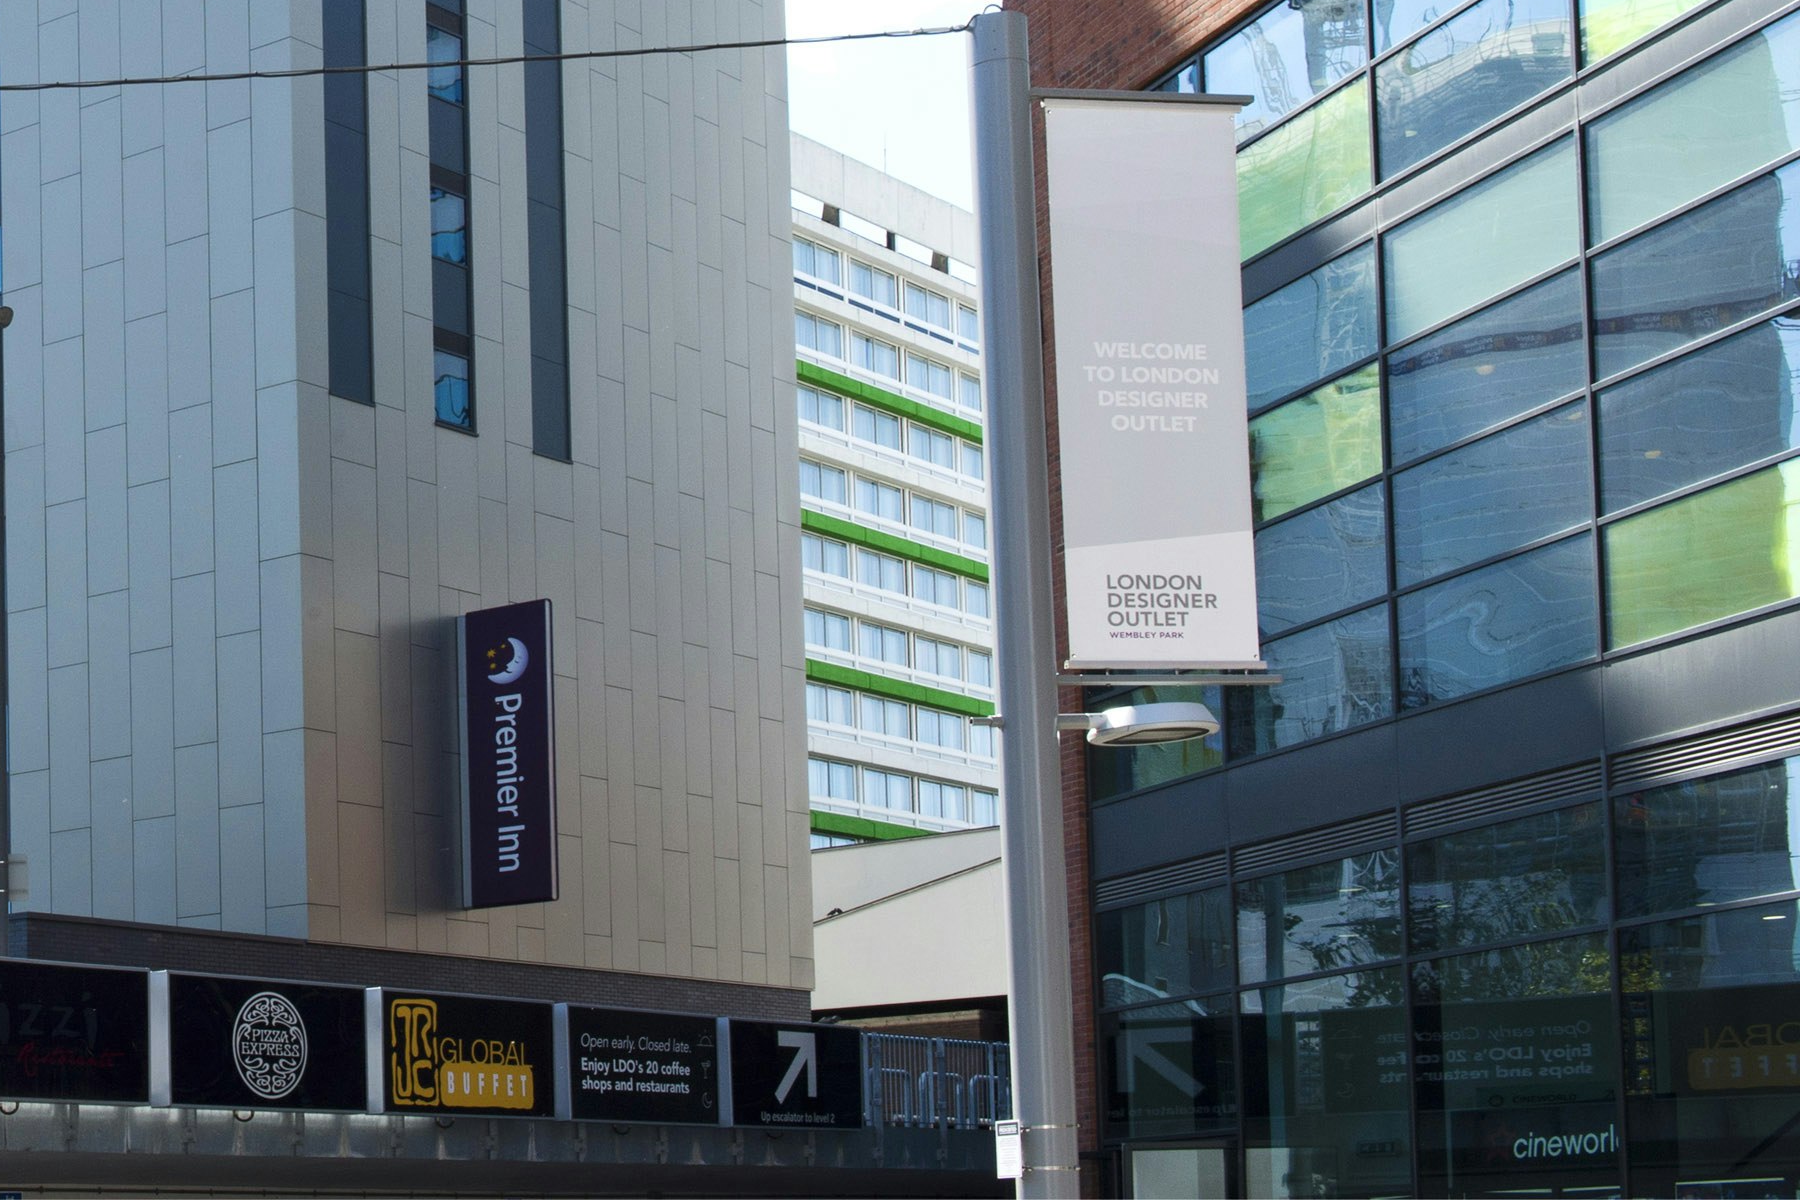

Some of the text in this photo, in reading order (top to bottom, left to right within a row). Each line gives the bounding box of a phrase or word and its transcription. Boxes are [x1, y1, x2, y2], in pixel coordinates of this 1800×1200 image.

[1093, 341, 1207, 361] WELCOME
[1083, 365, 1219, 385] TO LONDON
[1098, 390, 1208, 409] DESIGNER
[1111, 414, 1197, 432] OUTLET
[1106, 574, 1202, 590] LONDON
[1107, 593, 1218, 609] DESIGNER
[1107, 611, 1189, 627] OUTLET
[1109, 631, 1184, 639] WEMBLEY PARK
[495, 693, 525, 873] Premier Inn
[252, 1028, 290, 1043] PIZZA
[580, 1032, 692, 1053] Open early. Closed late.
[241, 1041, 300, 1057] EXPRESS
[440, 1037, 532, 1068] GLOBAL
[581, 1057, 691, 1076] Enjoy LDO's 20 coffee
[447, 1071, 527, 1097] BUFFET
[582, 1075, 690, 1094] shops and restaurants
[761, 1111, 835, 1123] Up escalator to level 2
[1513, 1123, 1619, 1159] cineworl
